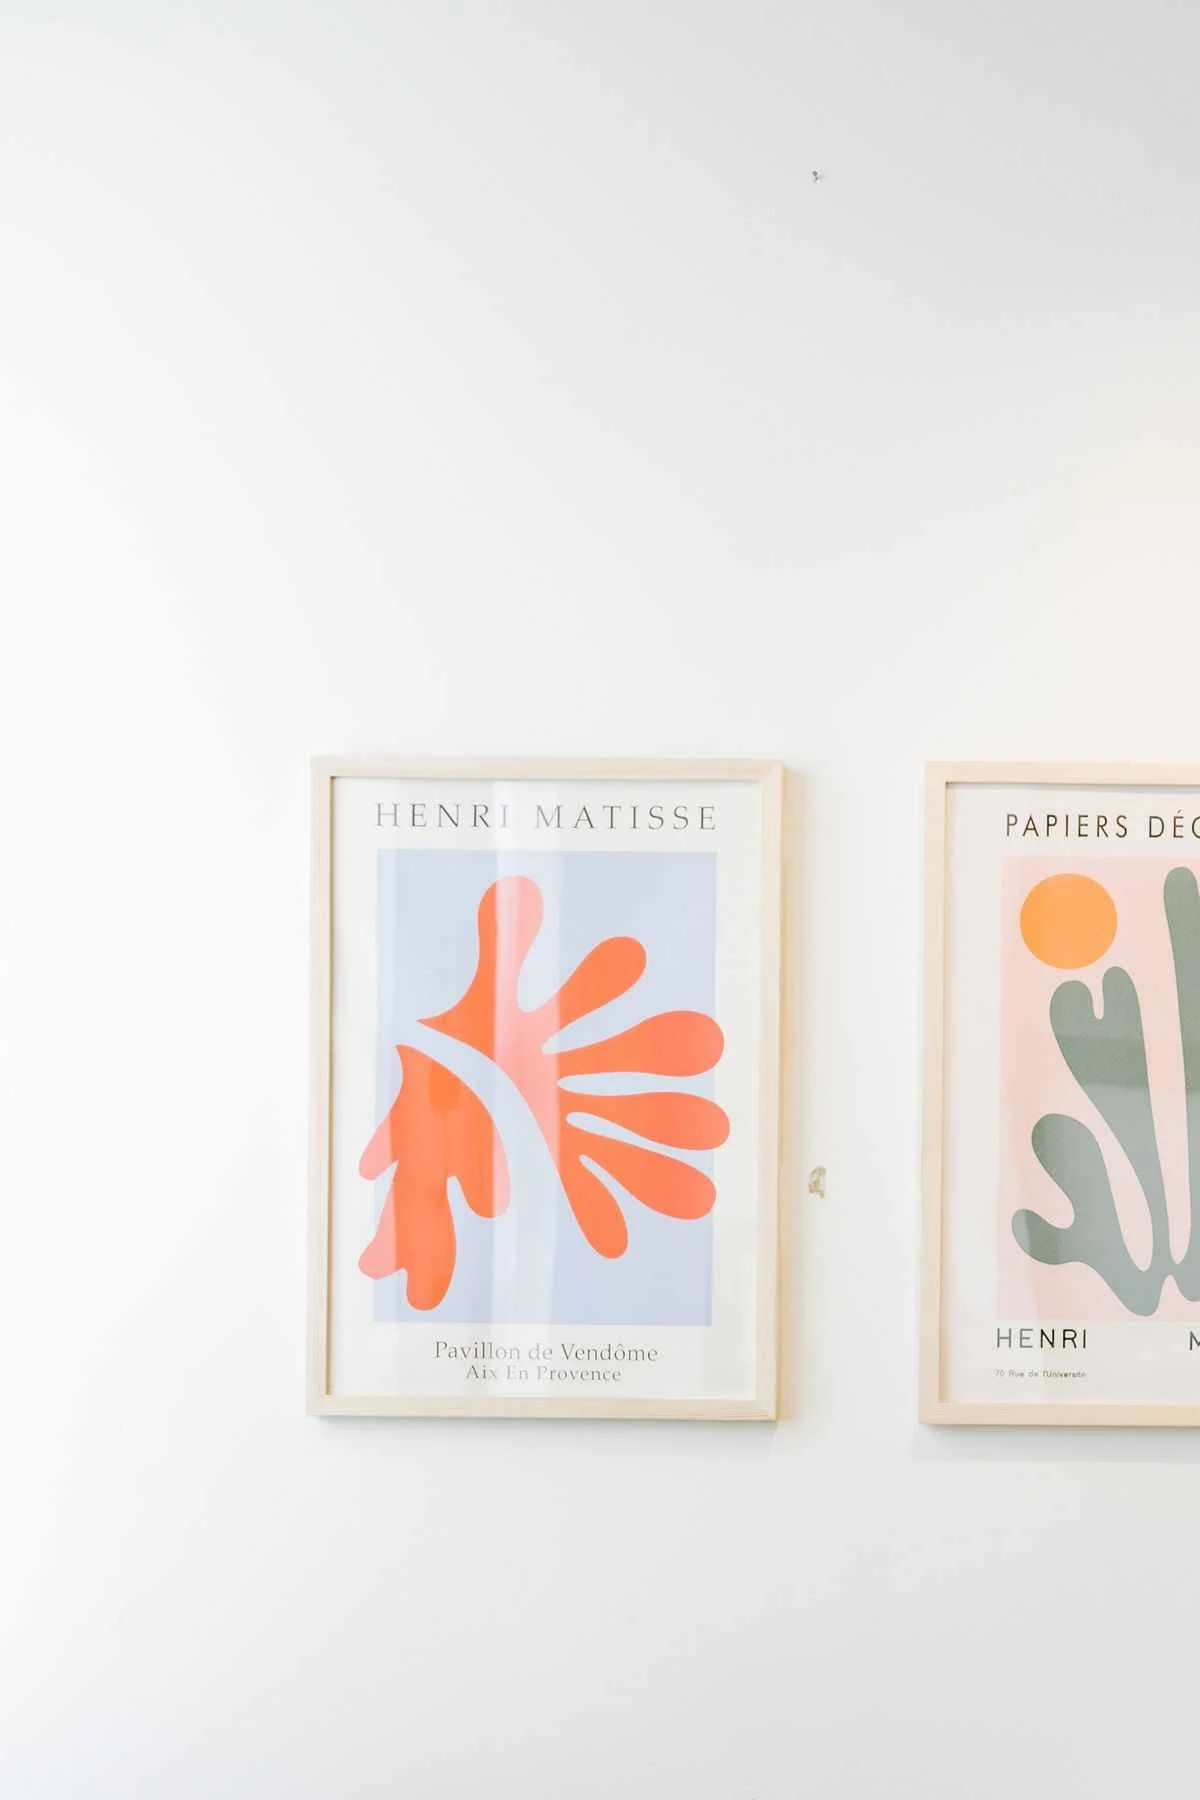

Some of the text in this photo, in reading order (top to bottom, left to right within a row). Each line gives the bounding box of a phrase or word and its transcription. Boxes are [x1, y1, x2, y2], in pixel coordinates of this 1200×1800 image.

[376, 802, 717, 831] HENRI MATISSE
[1006, 813, 1128, 838] PAPIERS
[997, 1328, 1087, 1349] HENRI
[434, 1341, 659, 1362] Pavillon de Vendôme
[466, 1364, 622, 1382] Aix En Provence
